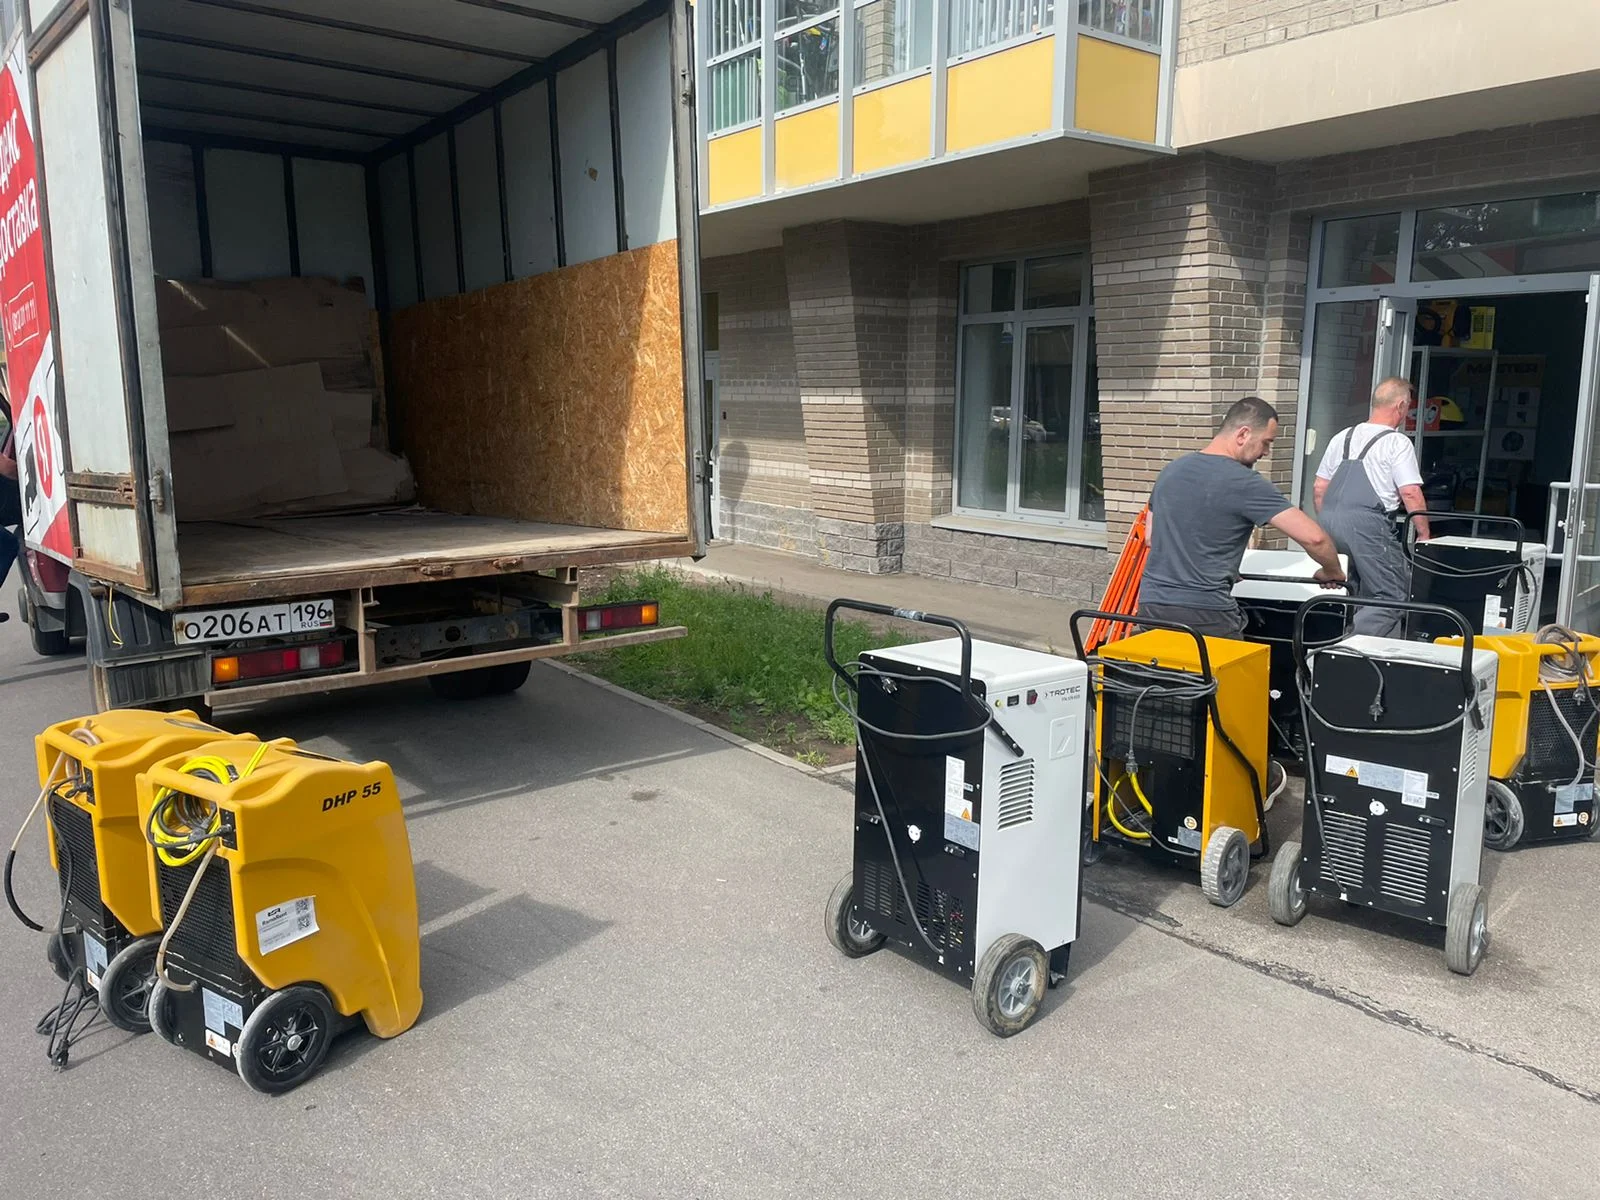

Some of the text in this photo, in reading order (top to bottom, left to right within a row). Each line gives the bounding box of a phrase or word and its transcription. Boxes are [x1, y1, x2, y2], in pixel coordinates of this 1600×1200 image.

[293, 602, 328, 621] 196
[301, 620, 319, 629] RUS
[1049, 685, 1081, 697] TROTEC
[322, 781, 381, 812] DHP 55
